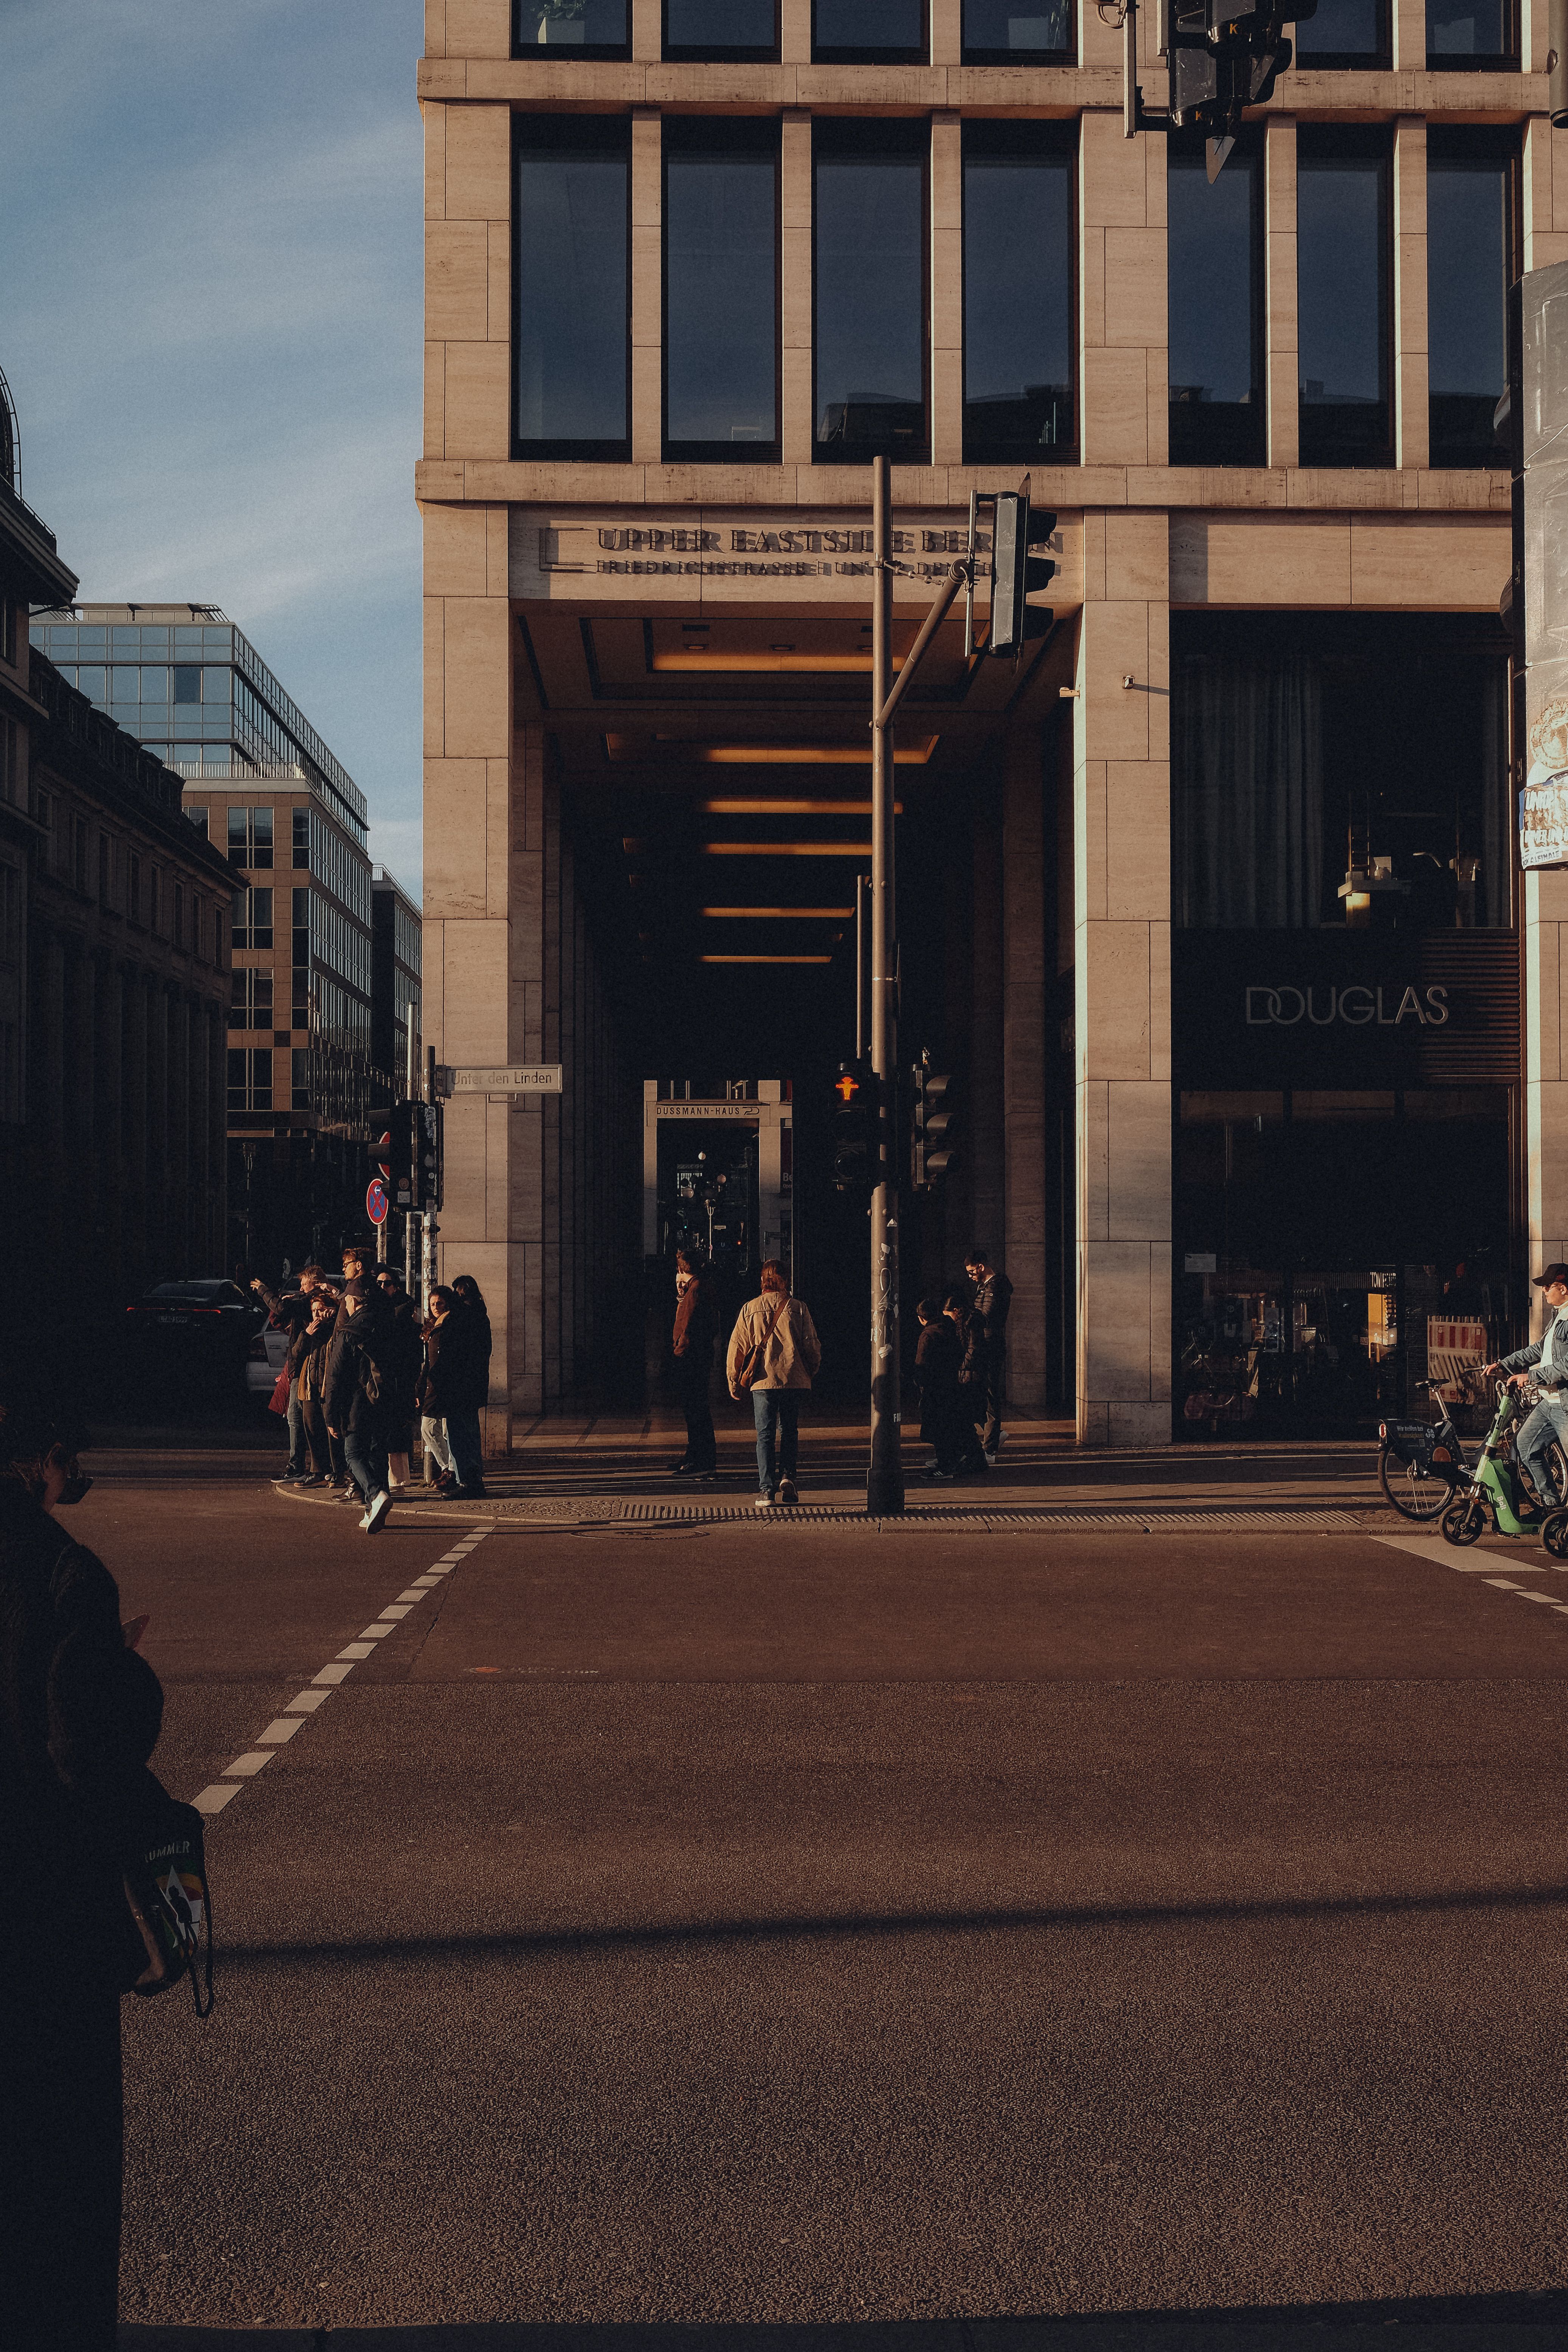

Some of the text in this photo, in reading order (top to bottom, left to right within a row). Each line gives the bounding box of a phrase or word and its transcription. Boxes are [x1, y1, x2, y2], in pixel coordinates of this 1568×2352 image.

[596, 528, 715, 552] UPPER
[596, 560, 805, 575] FRIEDRICHSTRASSE
[1247, 986, 1449, 1024] DOUGLAS
[451, 1072, 483, 1085] Unter
[488, 1071, 509, 1084] den
[514, 1071, 552, 1084] Linden
[1497, 1496, 1507, 1510] Bolt
